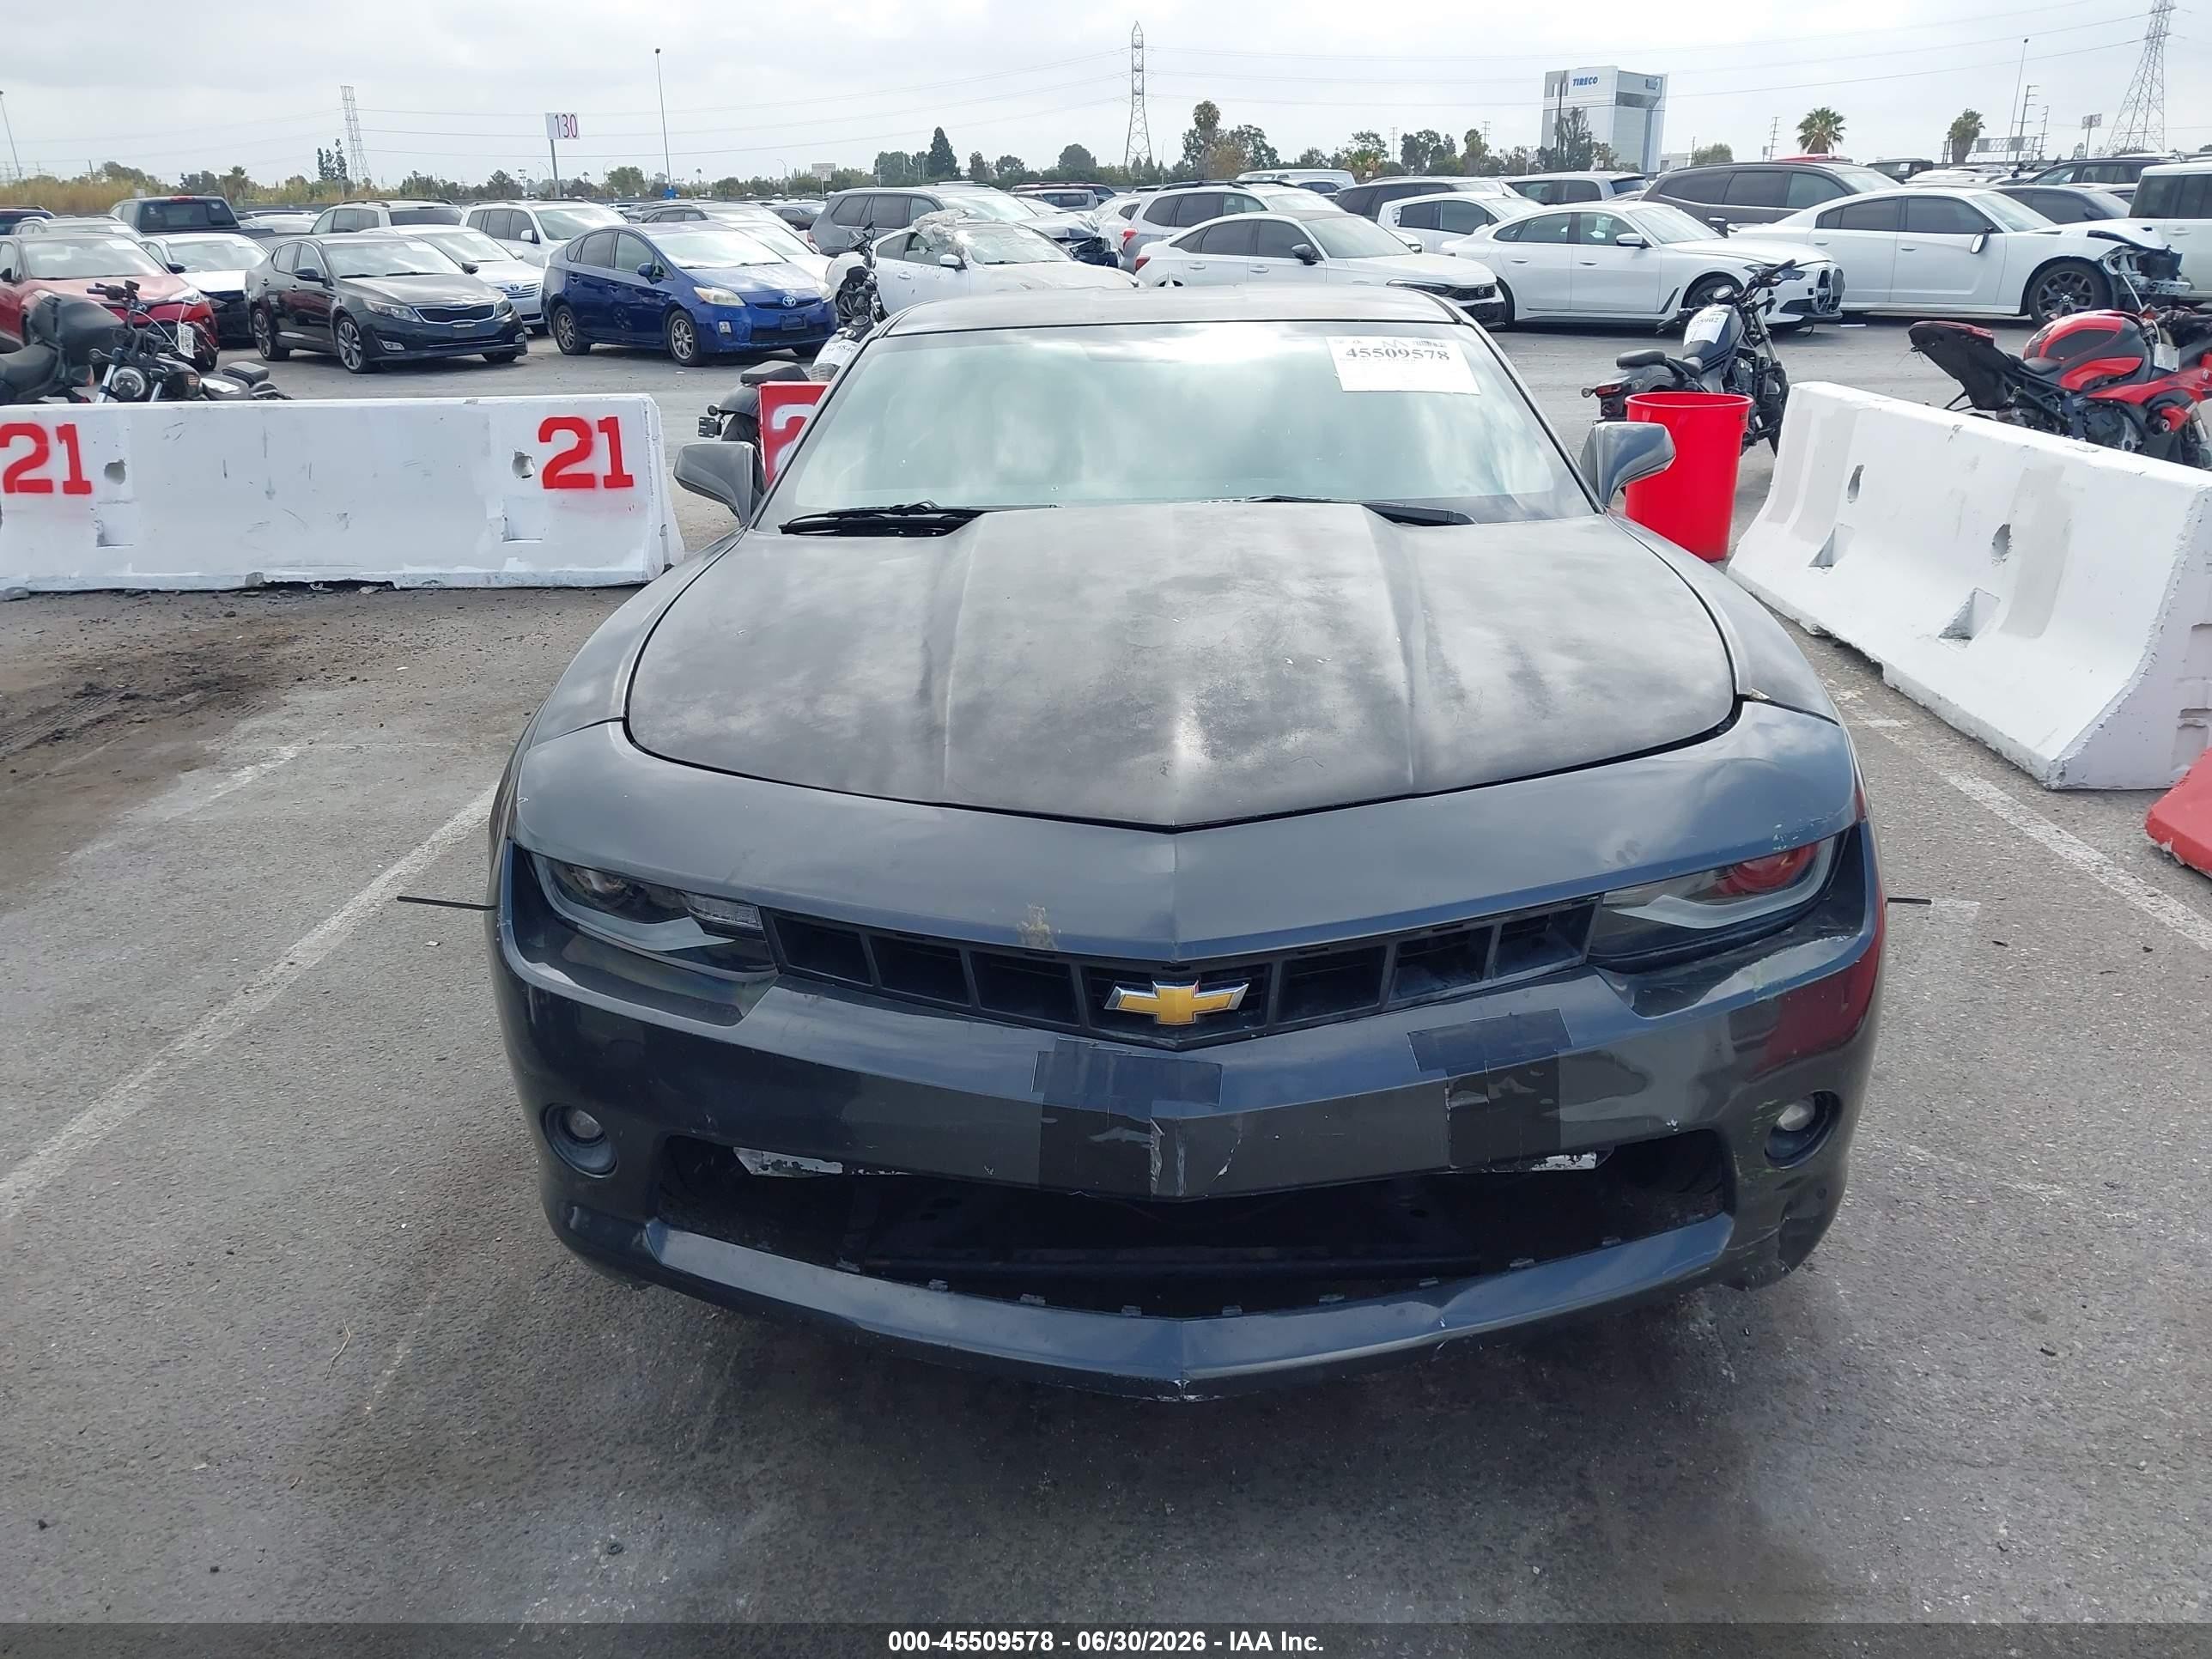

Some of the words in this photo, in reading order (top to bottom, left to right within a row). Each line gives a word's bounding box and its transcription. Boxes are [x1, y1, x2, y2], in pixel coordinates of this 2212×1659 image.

[1572, 76, 1599, 87] TIRECO
[554, 113, 578, 138] 130
[1346, 348, 1450, 361] 45509578
[0, 422, 92, 495] 21
[538, 416, 634, 489] 21
